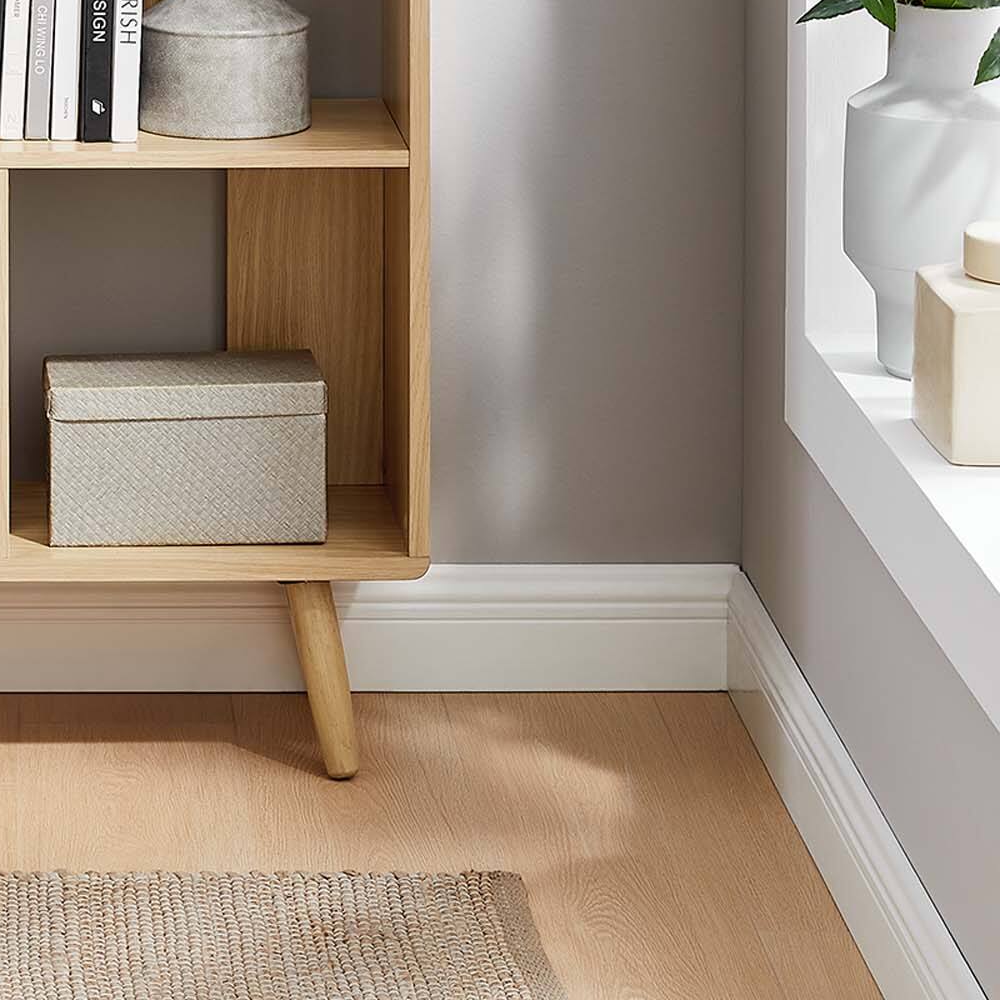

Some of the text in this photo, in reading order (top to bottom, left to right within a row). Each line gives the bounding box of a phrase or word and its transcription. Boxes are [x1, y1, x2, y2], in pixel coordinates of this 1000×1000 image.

[34, 5, 47, 75] CHI WING LO
